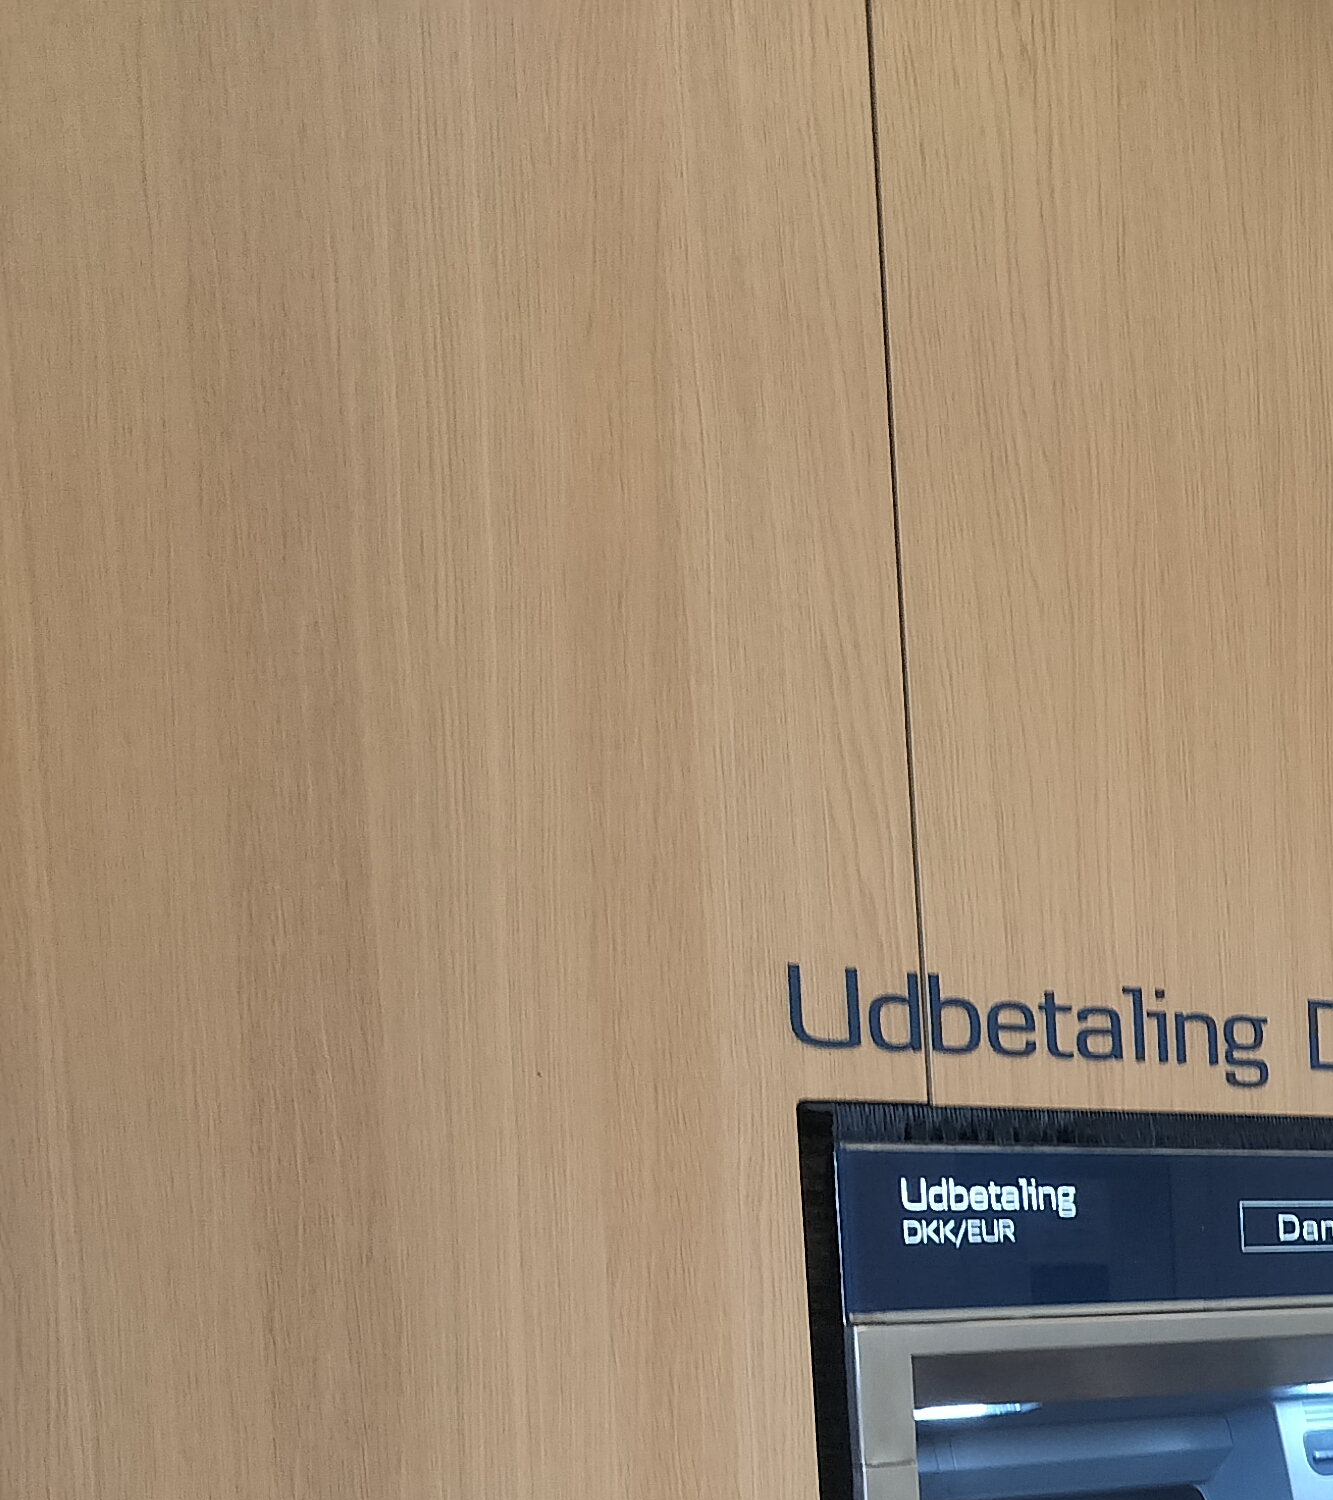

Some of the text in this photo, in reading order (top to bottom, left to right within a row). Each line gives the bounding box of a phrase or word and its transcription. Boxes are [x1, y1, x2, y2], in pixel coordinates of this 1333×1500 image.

[787, 963, 1269, 1088] Udbetaling
[900, 1177, 1077, 1218] Udbetaling
[902, 1217, 1017, 1250] DKK/EUR
